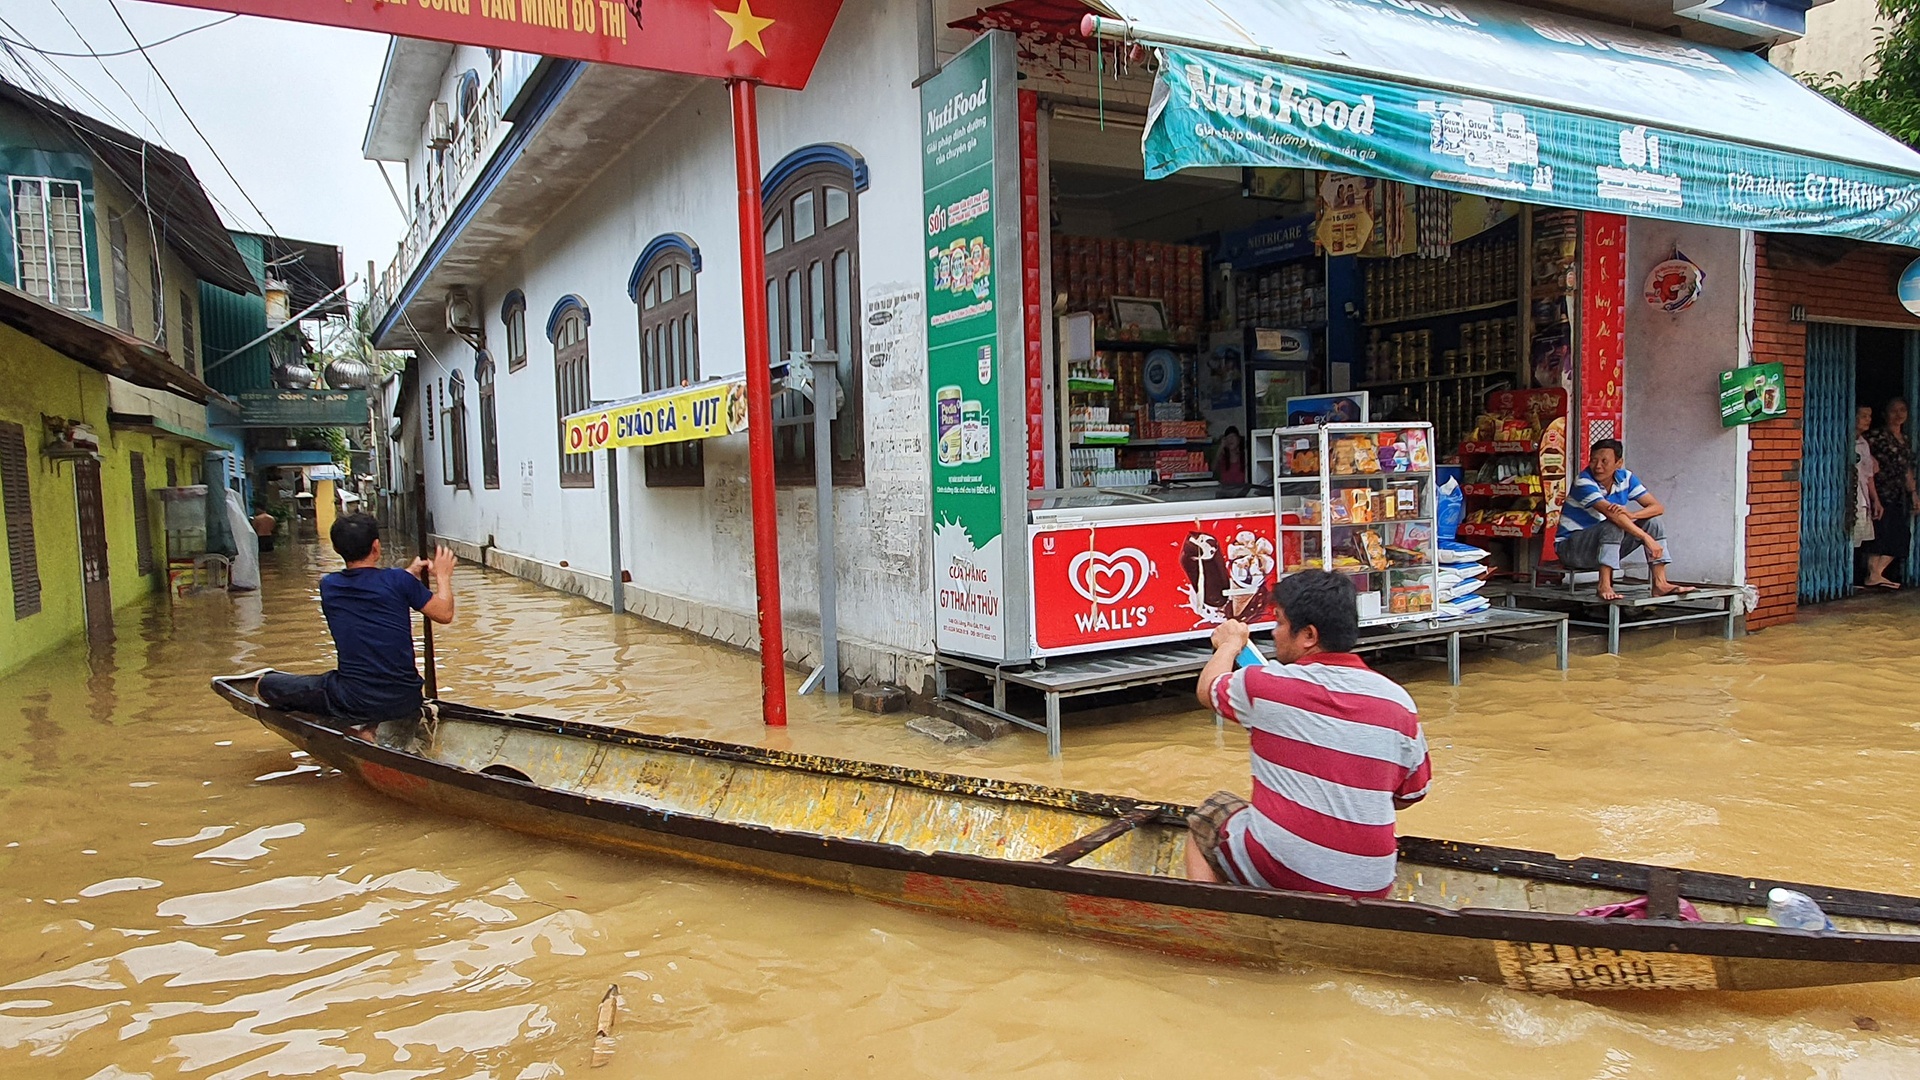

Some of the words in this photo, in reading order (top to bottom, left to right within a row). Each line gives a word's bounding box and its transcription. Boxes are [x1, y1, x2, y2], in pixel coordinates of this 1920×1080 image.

[521, 0, 569, 30] MINH
[599, 0, 628, 46] THỊ
[926, 78, 987, 136] NutiFood
[1185, 64, 1376, 135] NutiFood
[1468, 118, 1488, 131] Grow
[1268, 132, 1306, 148] dưỡng
[1359, 148, 1377, 160] gia
[1756, 176, 1795, 198] HÀNG
[1804, 173, 1826, 202] G7
[1826, 175, 1886, 211] THANH
[940, 209, 947, 231] 1
[1248, 225, 1302, 248] NUTRICARE
[616, 408, 654, 439] CHÁO
[657, 400, 677, 434] GÀ
[692, 396, 721, 433] VỊT
[1298, 414, 1326, 425] kex
[939, 589, 949, 608] G7
[950, 590, 976, 613] THANH
[977, 590, 998, 617] THỦY
[1074, 605, 1148, 634] WALL'S
